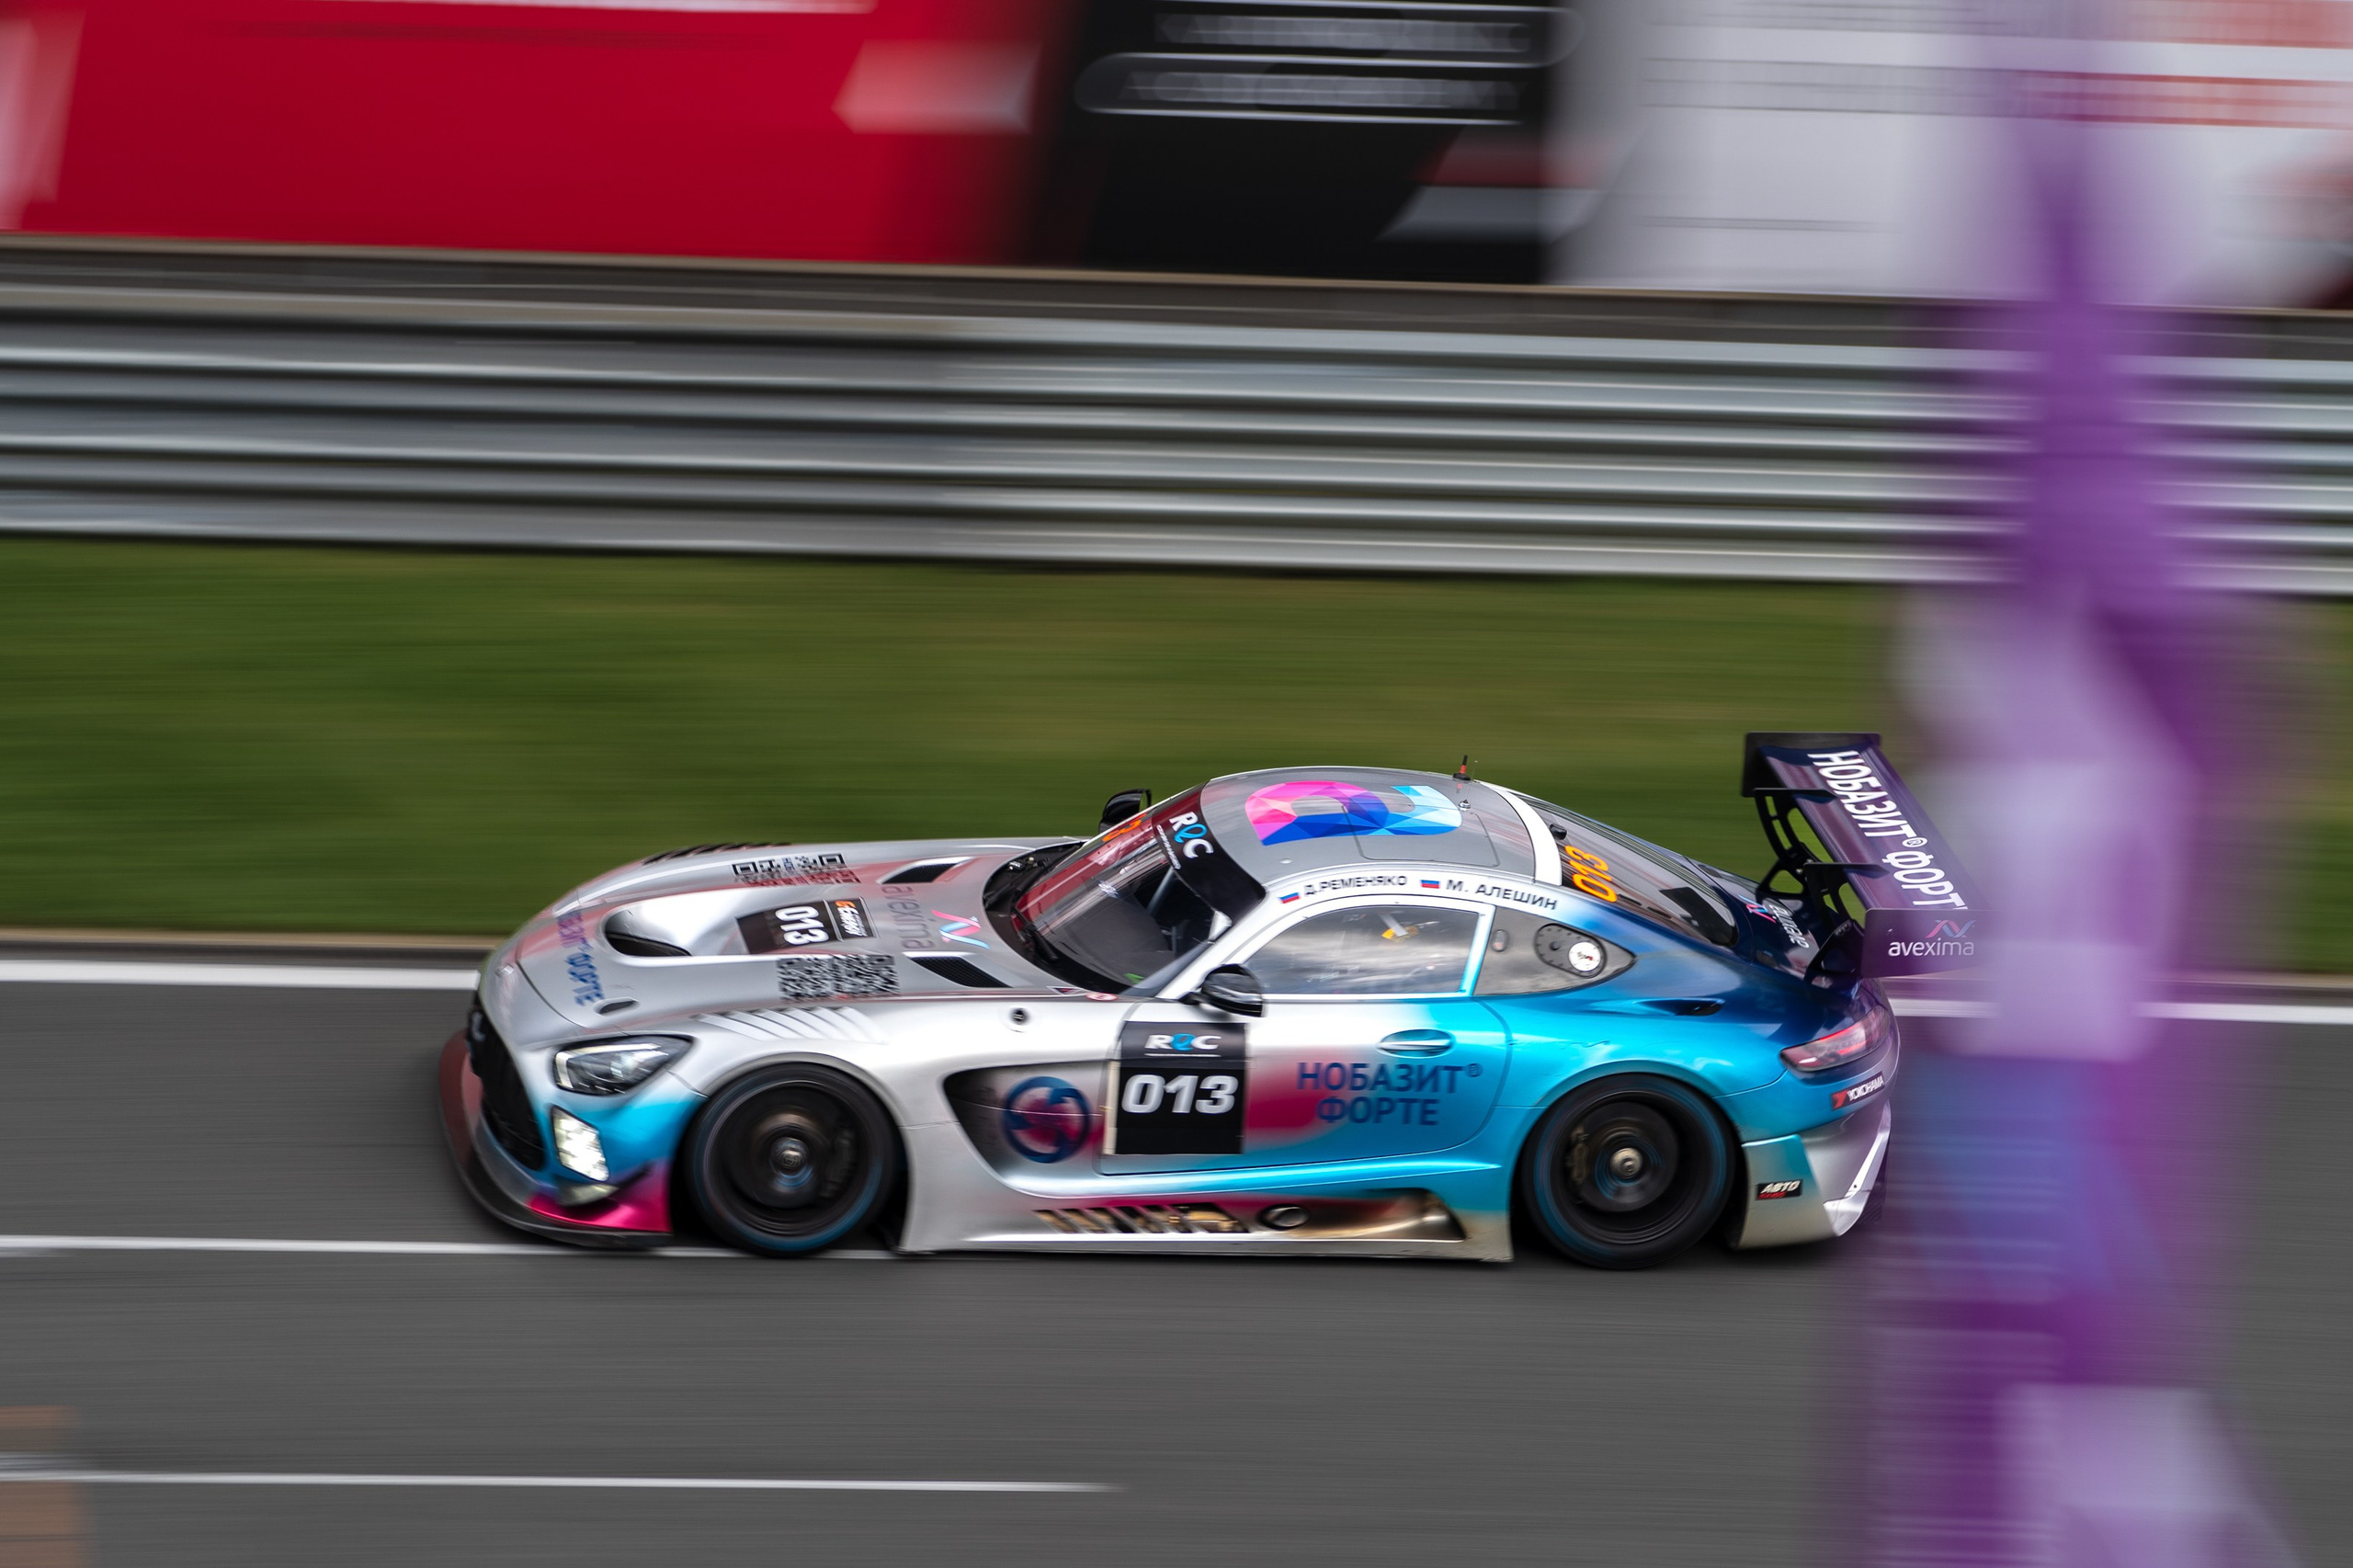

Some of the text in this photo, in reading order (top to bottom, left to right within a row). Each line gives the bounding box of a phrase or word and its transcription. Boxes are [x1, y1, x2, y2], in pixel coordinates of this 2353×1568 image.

[1446, 879, 1559, 910] М. АЛЕШИН
[1564, 845, 1618, 903] 013
[1881, 850, 1969, 910] ФОРТ
[775, 905, 830, 946] 013
[1888, 937, 1975, 957] avexima
[1121, 1074, 1239, 1115] 013
[1317, 1096, 1440, 1126] ФОРТЕ
